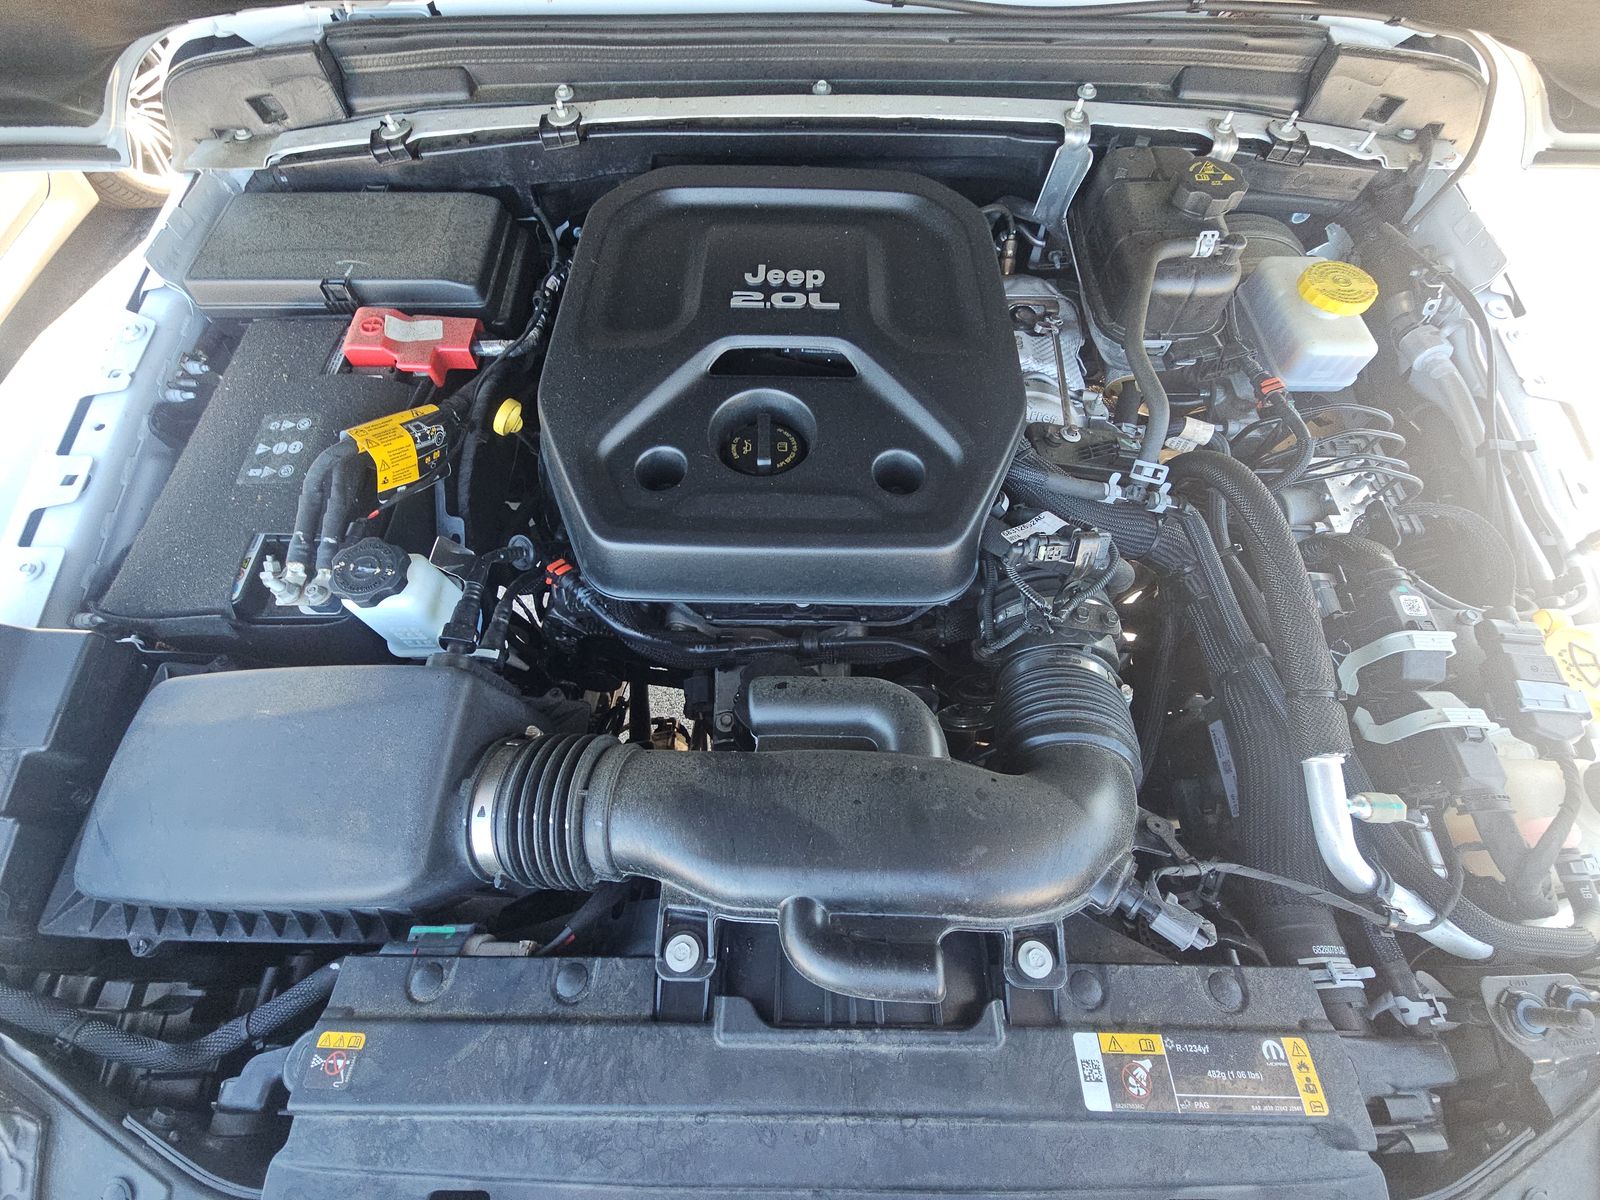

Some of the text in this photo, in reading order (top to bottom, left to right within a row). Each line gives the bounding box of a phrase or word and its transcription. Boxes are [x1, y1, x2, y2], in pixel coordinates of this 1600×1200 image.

[744, 264, 826, 289] Jeep
[730, 291, 840, 309] 2.0L
[1175, 1043, 1210, 1054] R-1234yf
[1207, 1070, 1263, 1081] 482g (1.06 lbs)
[1194, 1101, 1210, 1109] PAG
